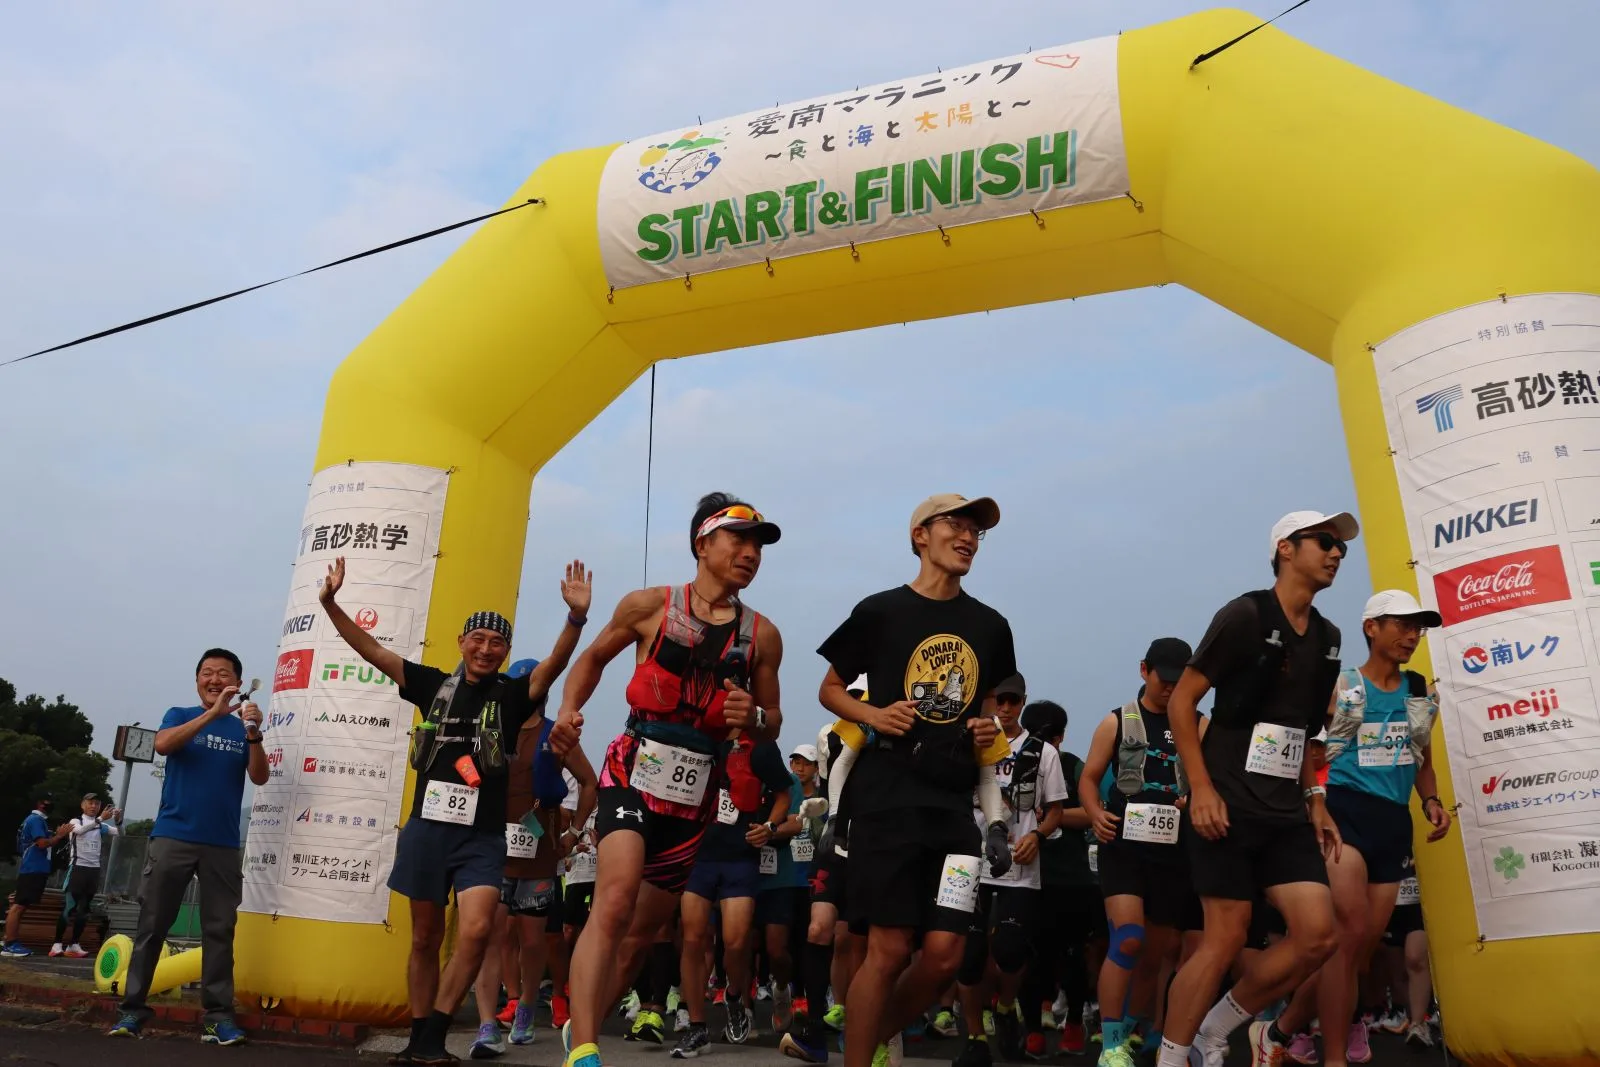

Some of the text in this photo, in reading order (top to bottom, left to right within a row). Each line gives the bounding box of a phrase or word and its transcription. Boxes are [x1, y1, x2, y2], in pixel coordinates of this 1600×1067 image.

[746, 62, 1023, 139] 愛南マラニック
[636, 130, 1077, 263] START&FINISH
[1477, 319, 1546, 342] 特別協賛
[1471, 369, 1600, 420] 高砂熱
[1434, 498, 1539, 549] NIKKEI
[311, 522, 409, 552] 高砂熱学
[1460, 598, 1496, 612] BOTTLERS
[1498, 592, 1521, 604] JAPAN
[920, 641, 963, 662] DONARAI
[1489, 634, 1561, 667] 南レク
[929, 652, 958, 671] LOVER
[1487, 687, 1560, 721] meiji
[1482, 718, 1575, 743] 四国明治株式会社
[672, 765, 698, 786] 86
[1557, 769, 1599, 783] Group
[448, 795, 467, 810] 82
[720, 799, 736, 813] 59
[1148, 815, 1175, 831] 456
[510, 833, 534, 847] 392
[796, 844, 813, 855] 203
[763, 854, 774, 865] 74
[1530, 839, 1600, 864] 有限会社 凝
[291, 866, 371, 883] ファーム合同会社
[1400, 885, 1420, 895] 336
